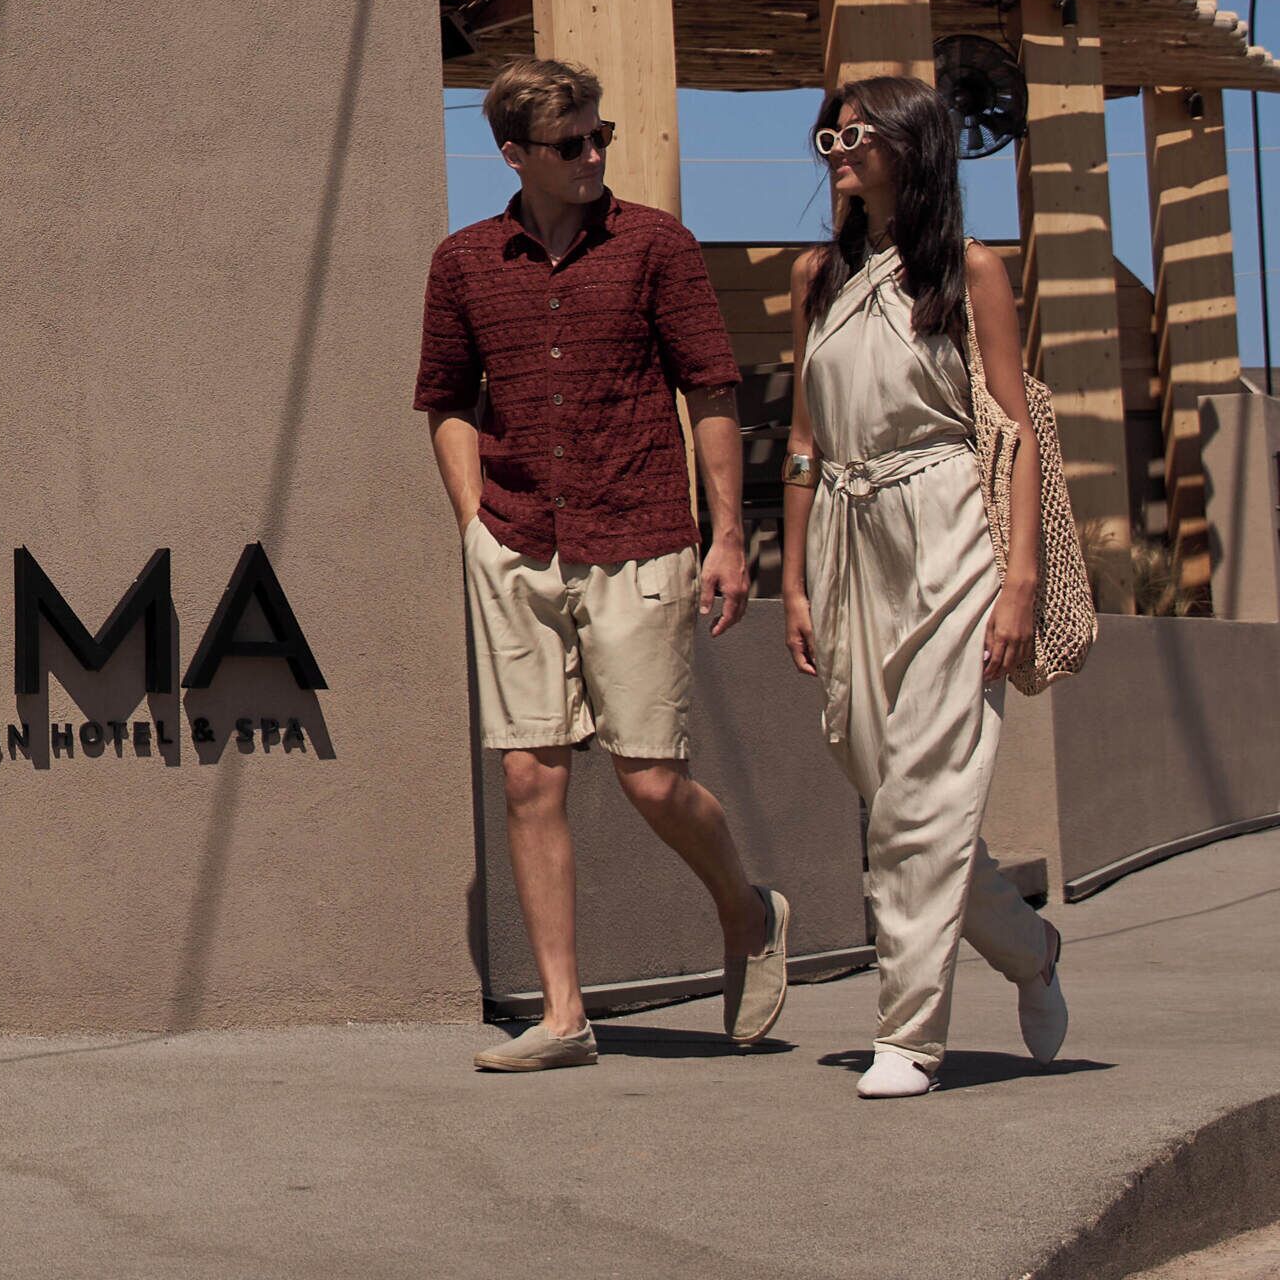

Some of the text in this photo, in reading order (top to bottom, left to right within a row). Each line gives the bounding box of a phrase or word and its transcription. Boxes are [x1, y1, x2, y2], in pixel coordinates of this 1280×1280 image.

[51, 721, 174, 748] HOTEL
[192, 717, 216, 743] &
[235, 716, 306, 743] SPA
